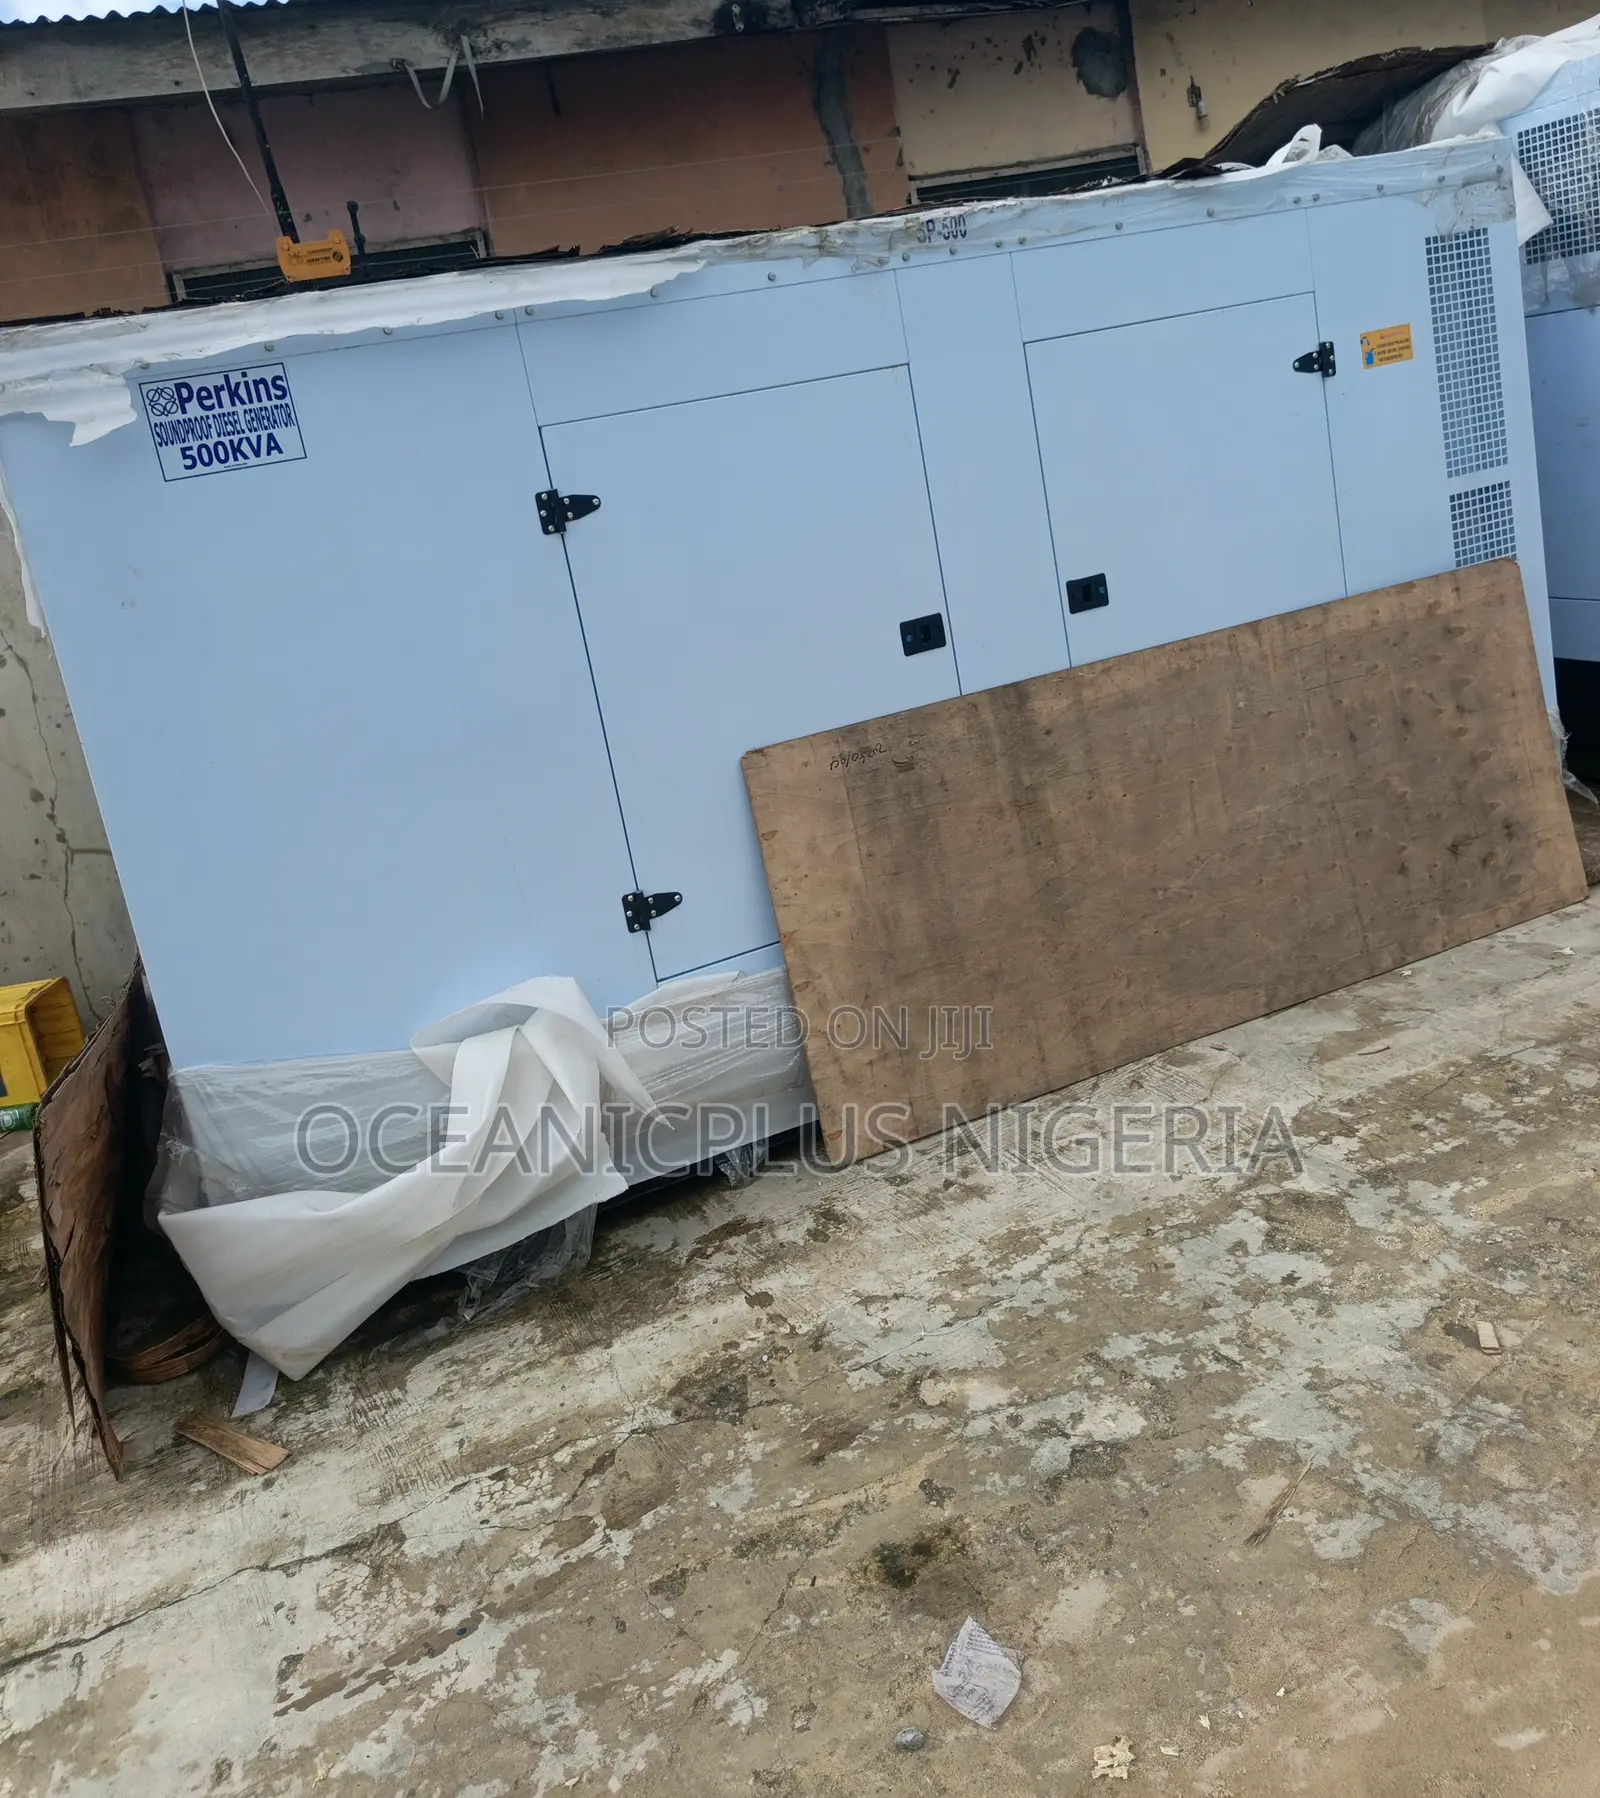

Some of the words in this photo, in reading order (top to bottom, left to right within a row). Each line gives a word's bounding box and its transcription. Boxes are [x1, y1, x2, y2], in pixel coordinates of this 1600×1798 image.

[174, 371, 288, 415] Perkins
[153, 415, 213, 448] SOUNDPROOF
[212, 408, 246, 440] DIESEL
[244, 402, 296, 434] GENERATOR
[180, 431, 284, 471] 500KVA
